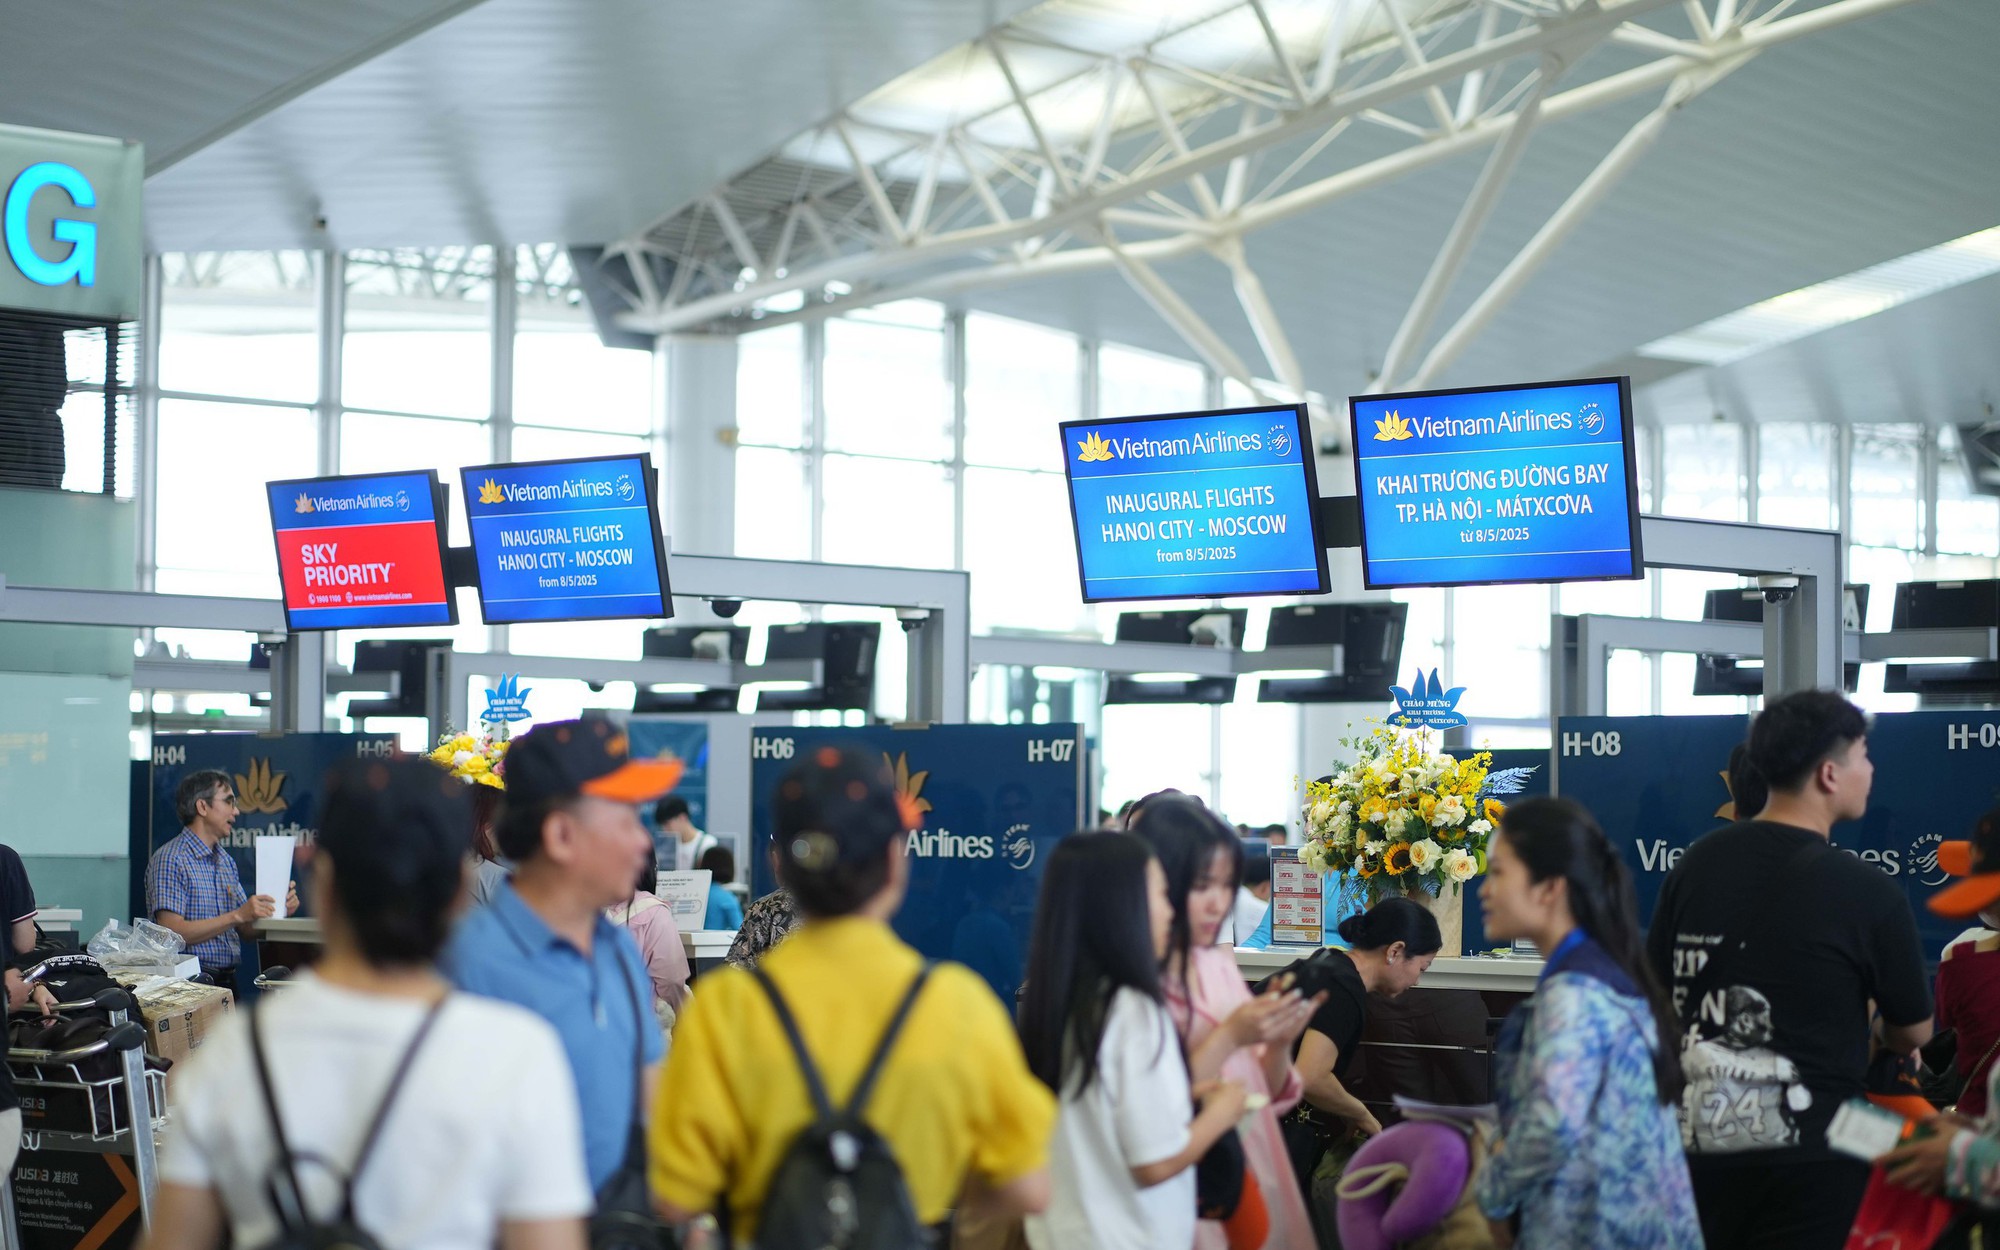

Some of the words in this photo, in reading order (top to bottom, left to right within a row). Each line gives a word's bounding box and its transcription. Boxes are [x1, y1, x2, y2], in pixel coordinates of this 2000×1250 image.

[4, 161, 97, 287] G
[1412, 417, 1498, 439] Vietnam
[1497, 409, 1573, 433] Airlines
[1112, 438, 1193, 460] Vietnam
[1192, 430, 1262, 454] Airlines
[503, 483, 563, 502] Vietnam
[562, 478, 613, 498] Airlines
[1376, 474, 1418, 496] KHAI
[1420, 469, 1496, 494] TRƯƠNG
[1499, 464, 1570, 488] ĐƯỜNG
[1574, 463, 1609, 485] BAY
[313, 496, 357, 513] Vietnam
[356, 494, 394, 511] Airlines
[1105, 489, 1203, 514] INAUGURAL
[1205, 485, 1275, 509] FLIGHTS
[1396, 503, 1419, 524] TP.
[1422, 499, 1447, 522] HÀ
[1451, 497, 1482, 525] NỘI
[1496, 493, 1593, 518] MÁTXCƠVA
[500, 528, 572, 548] INAUGURAL
[573, 523, 624, 544] FLIGHTS
[1101, 521, 1156, 543] HANOI
[1158, 519, 1194, 540] CITY
[1208, 514, 1287, 537] MOSCOW
[1460, 529, 1474, 543] từ
[1475, 527, 1530, 543] 8/5/2025
[301, 542, 338, 565] SKY
[498, 554, 539, 571] HANOI
[539, 551, 566, 569] CITY
[575, 547, 633, 567] MOSCOW
[1156, 548, 1184, 562] from
[1185, 546, 1236, 562] 8/5/2025
[304, 563, 391, 587] PRIORITY
[539, 575, 560, 588] from
[560, 574, 598, 588] 8/5/2025
[1402, 698, 1424, 707] CHÀO
[1426, 698, 1451, 708] MỪNG
[153, 745, 186, 766] H-04
[356, 740, 394, 759] H-05
[753, 737, 795, 759] H-06
[1027, 739, 1075, 762] H-07
[1562, 731, 1622, 757] H-08
[904, 828, 994, 859] Airlines
[1907, 833, 1943, 876] SKYTEAM
[1702, 1086, 1766, 1140] 24
[52, 1171, 79, 1185] 准时达
